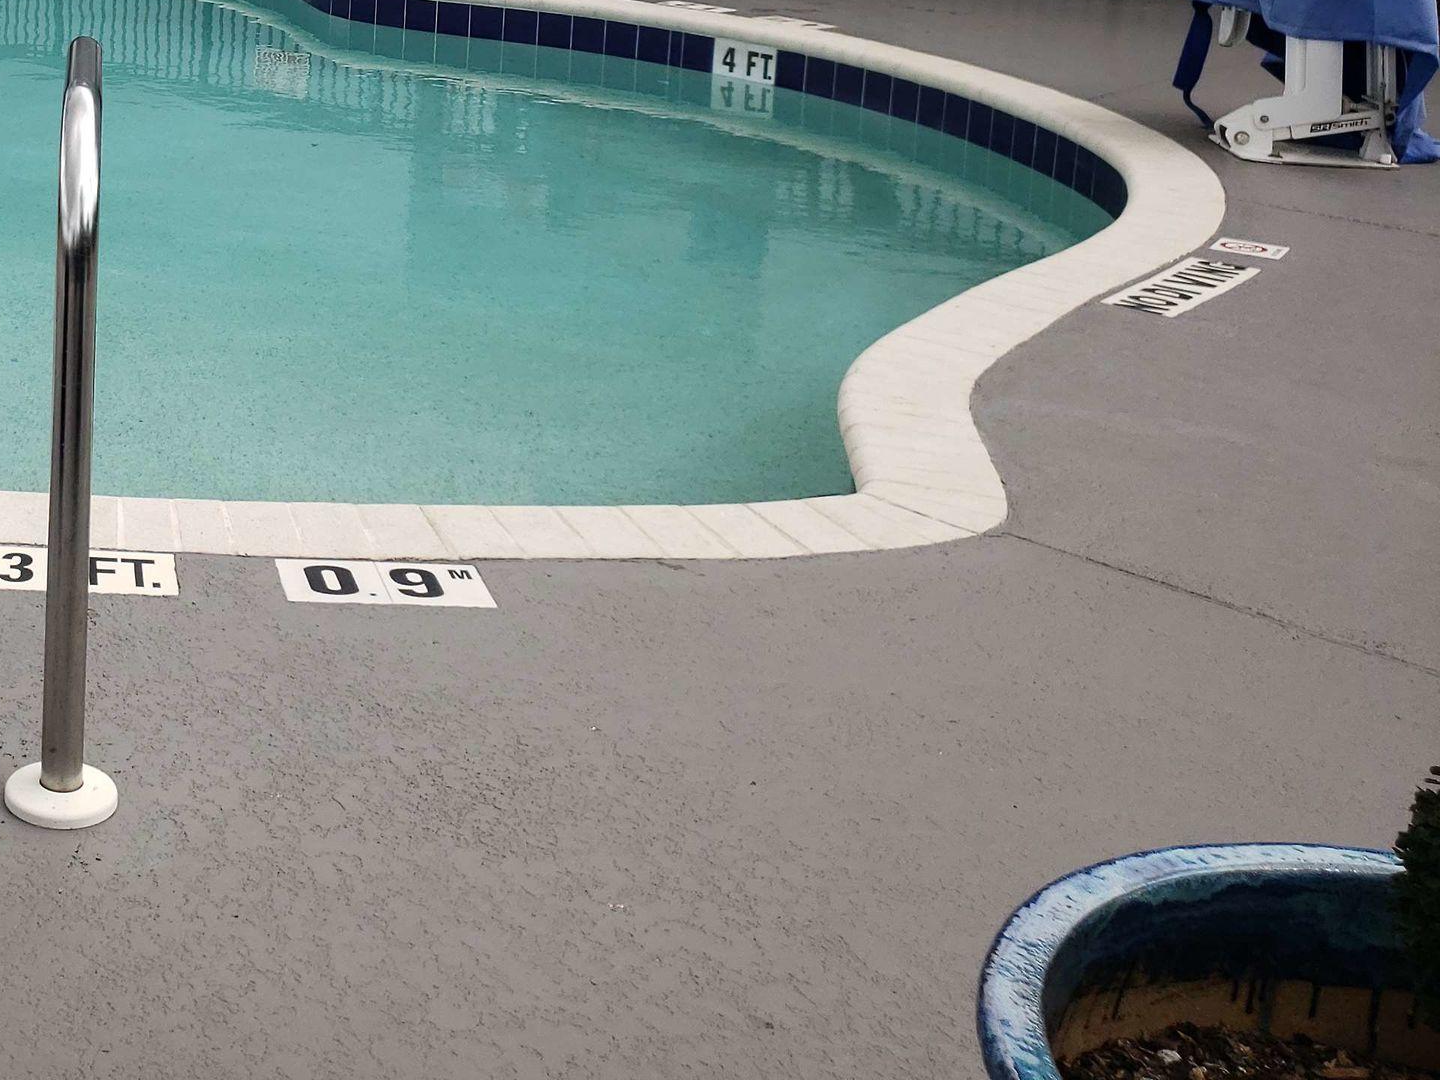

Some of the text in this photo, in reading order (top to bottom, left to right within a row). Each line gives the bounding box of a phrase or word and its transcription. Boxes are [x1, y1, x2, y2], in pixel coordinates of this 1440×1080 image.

[722, 47, 773, 80] 4 FT.
[89, 556, 161, 588] FT.
[303, 565, 445, 599] 0.9
